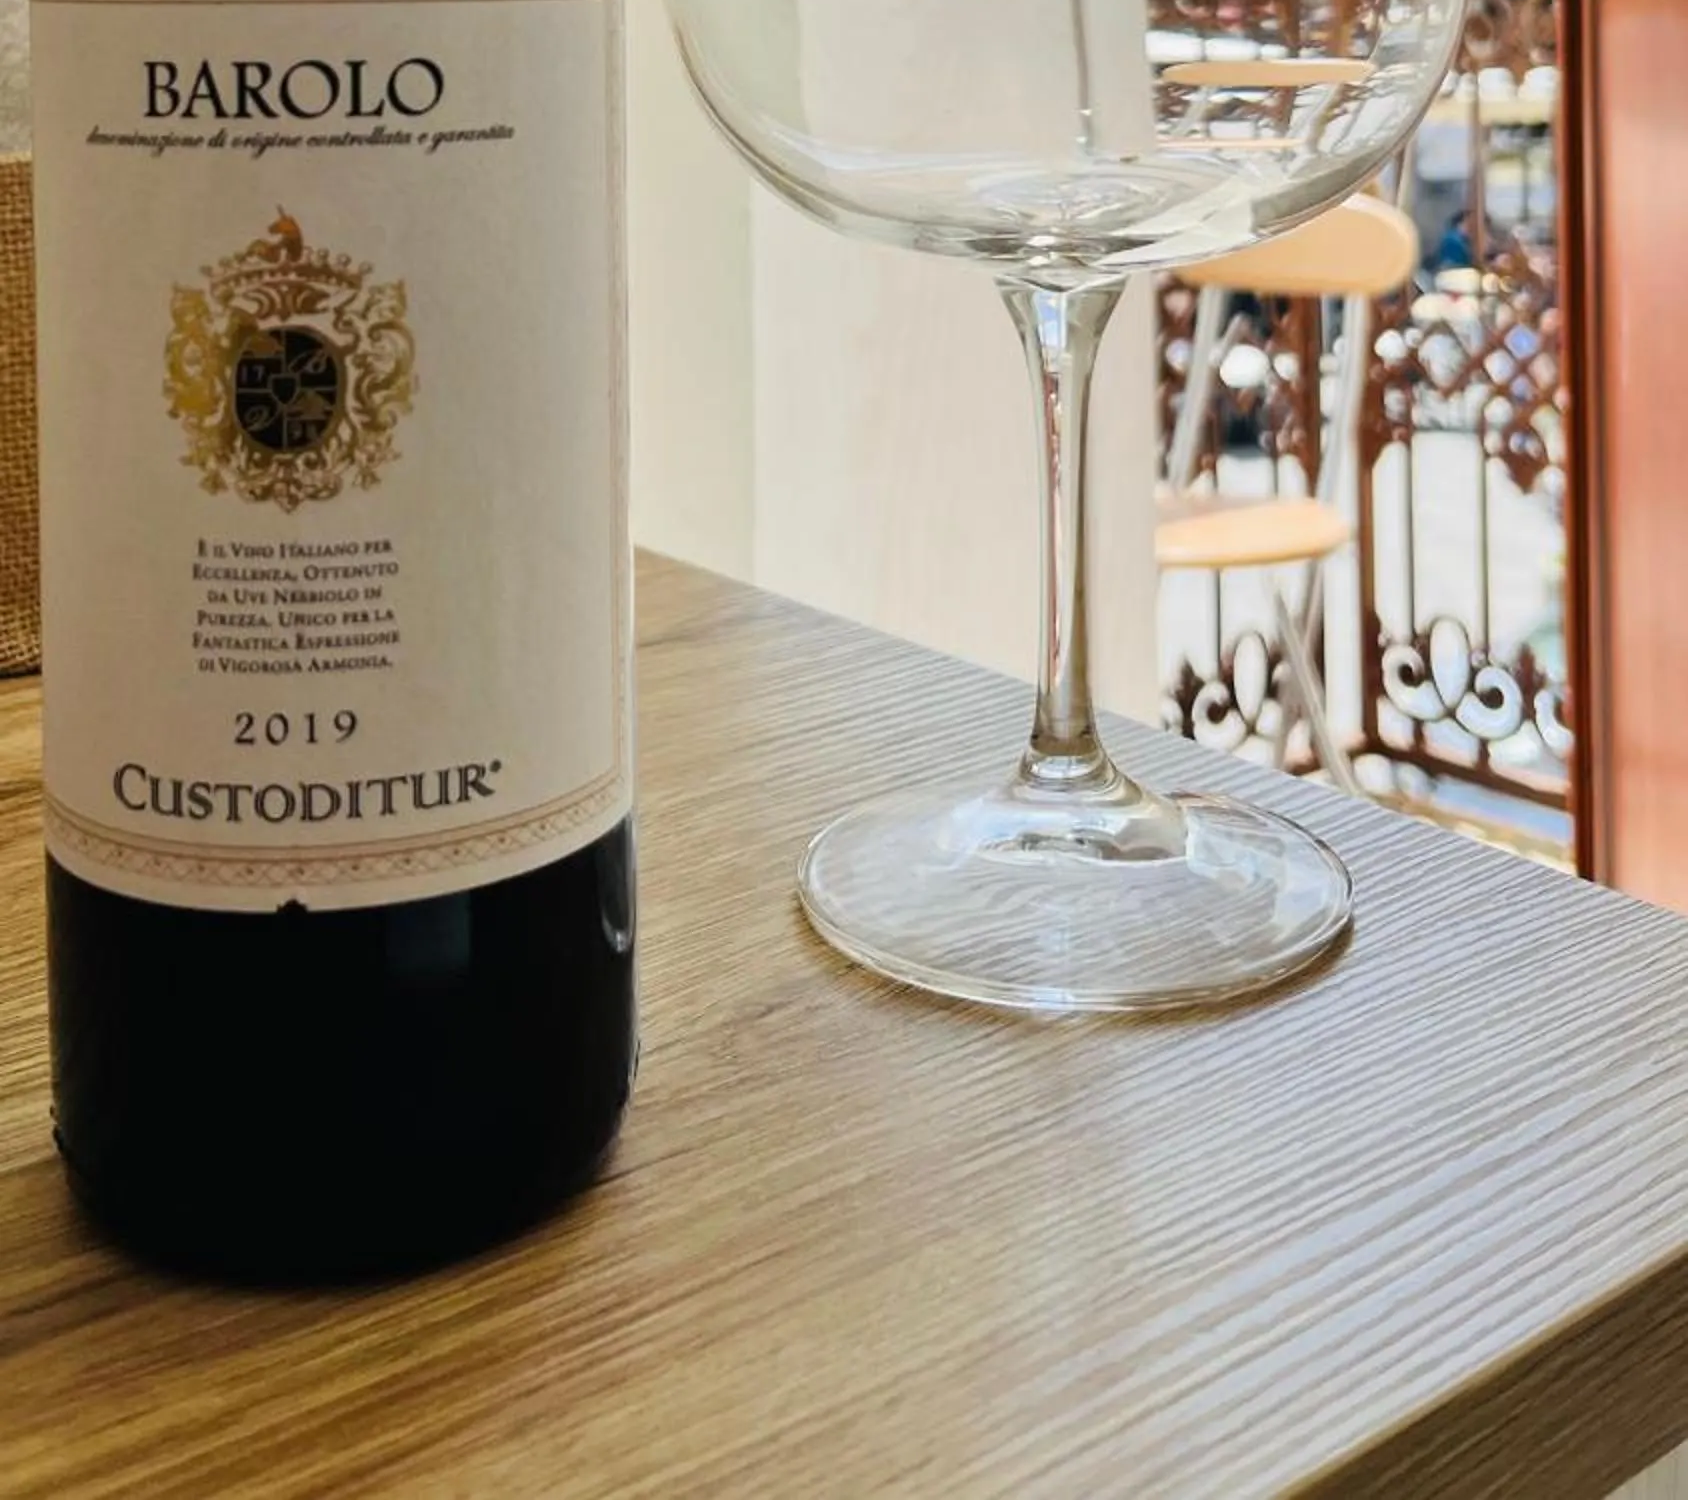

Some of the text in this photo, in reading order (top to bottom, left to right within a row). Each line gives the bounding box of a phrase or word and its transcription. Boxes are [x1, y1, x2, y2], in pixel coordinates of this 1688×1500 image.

[143, 57, 445, 119] BAROLO
[207, 127, 228, 148] di
[231, 131, 302, 160] origine
[234, 710, 358, 746] 2019
